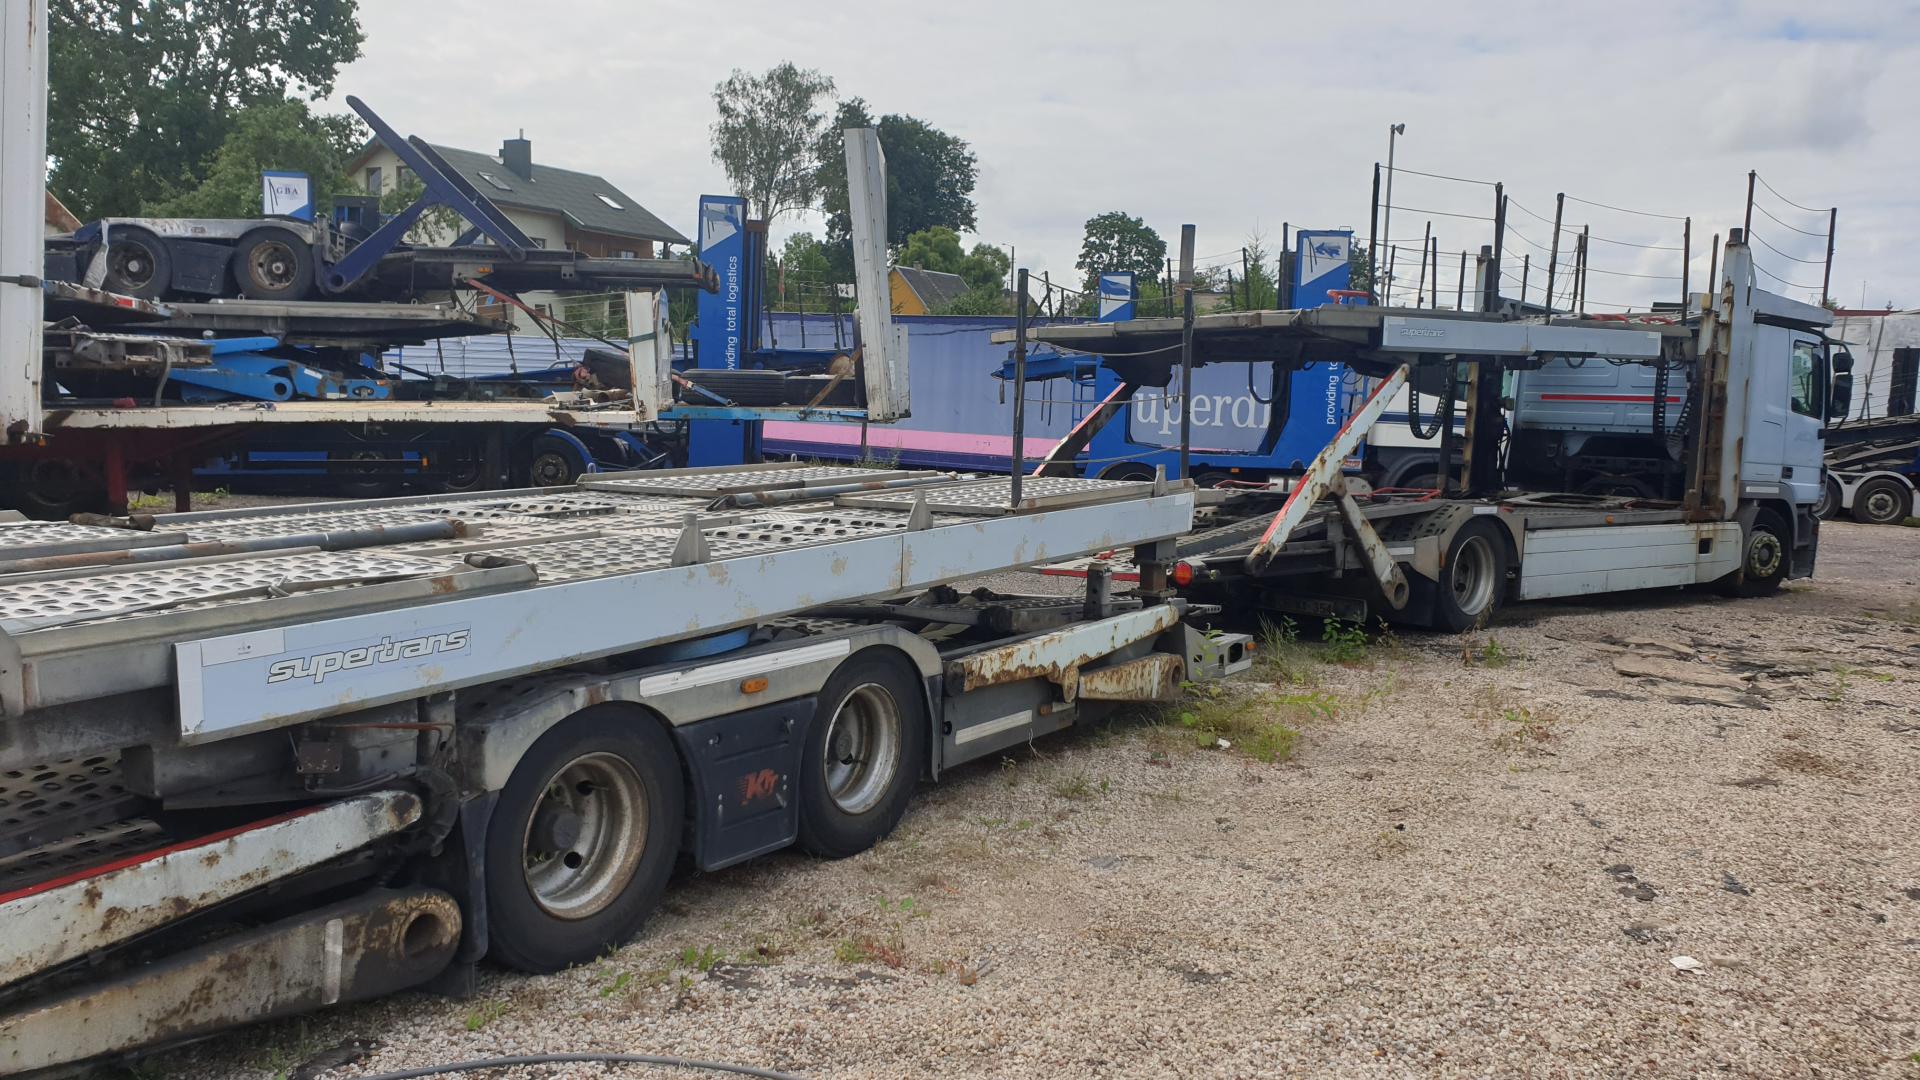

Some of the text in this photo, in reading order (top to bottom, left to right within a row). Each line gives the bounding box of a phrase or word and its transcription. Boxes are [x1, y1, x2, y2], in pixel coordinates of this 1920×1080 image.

[276, 186, 299, 195] GBA
[726, 255, 739, 303] logistics
[725, 306, 737, 331] total
[1326, 375, 1340, 425] providing
[266, 628, 471, 685] supertrans
